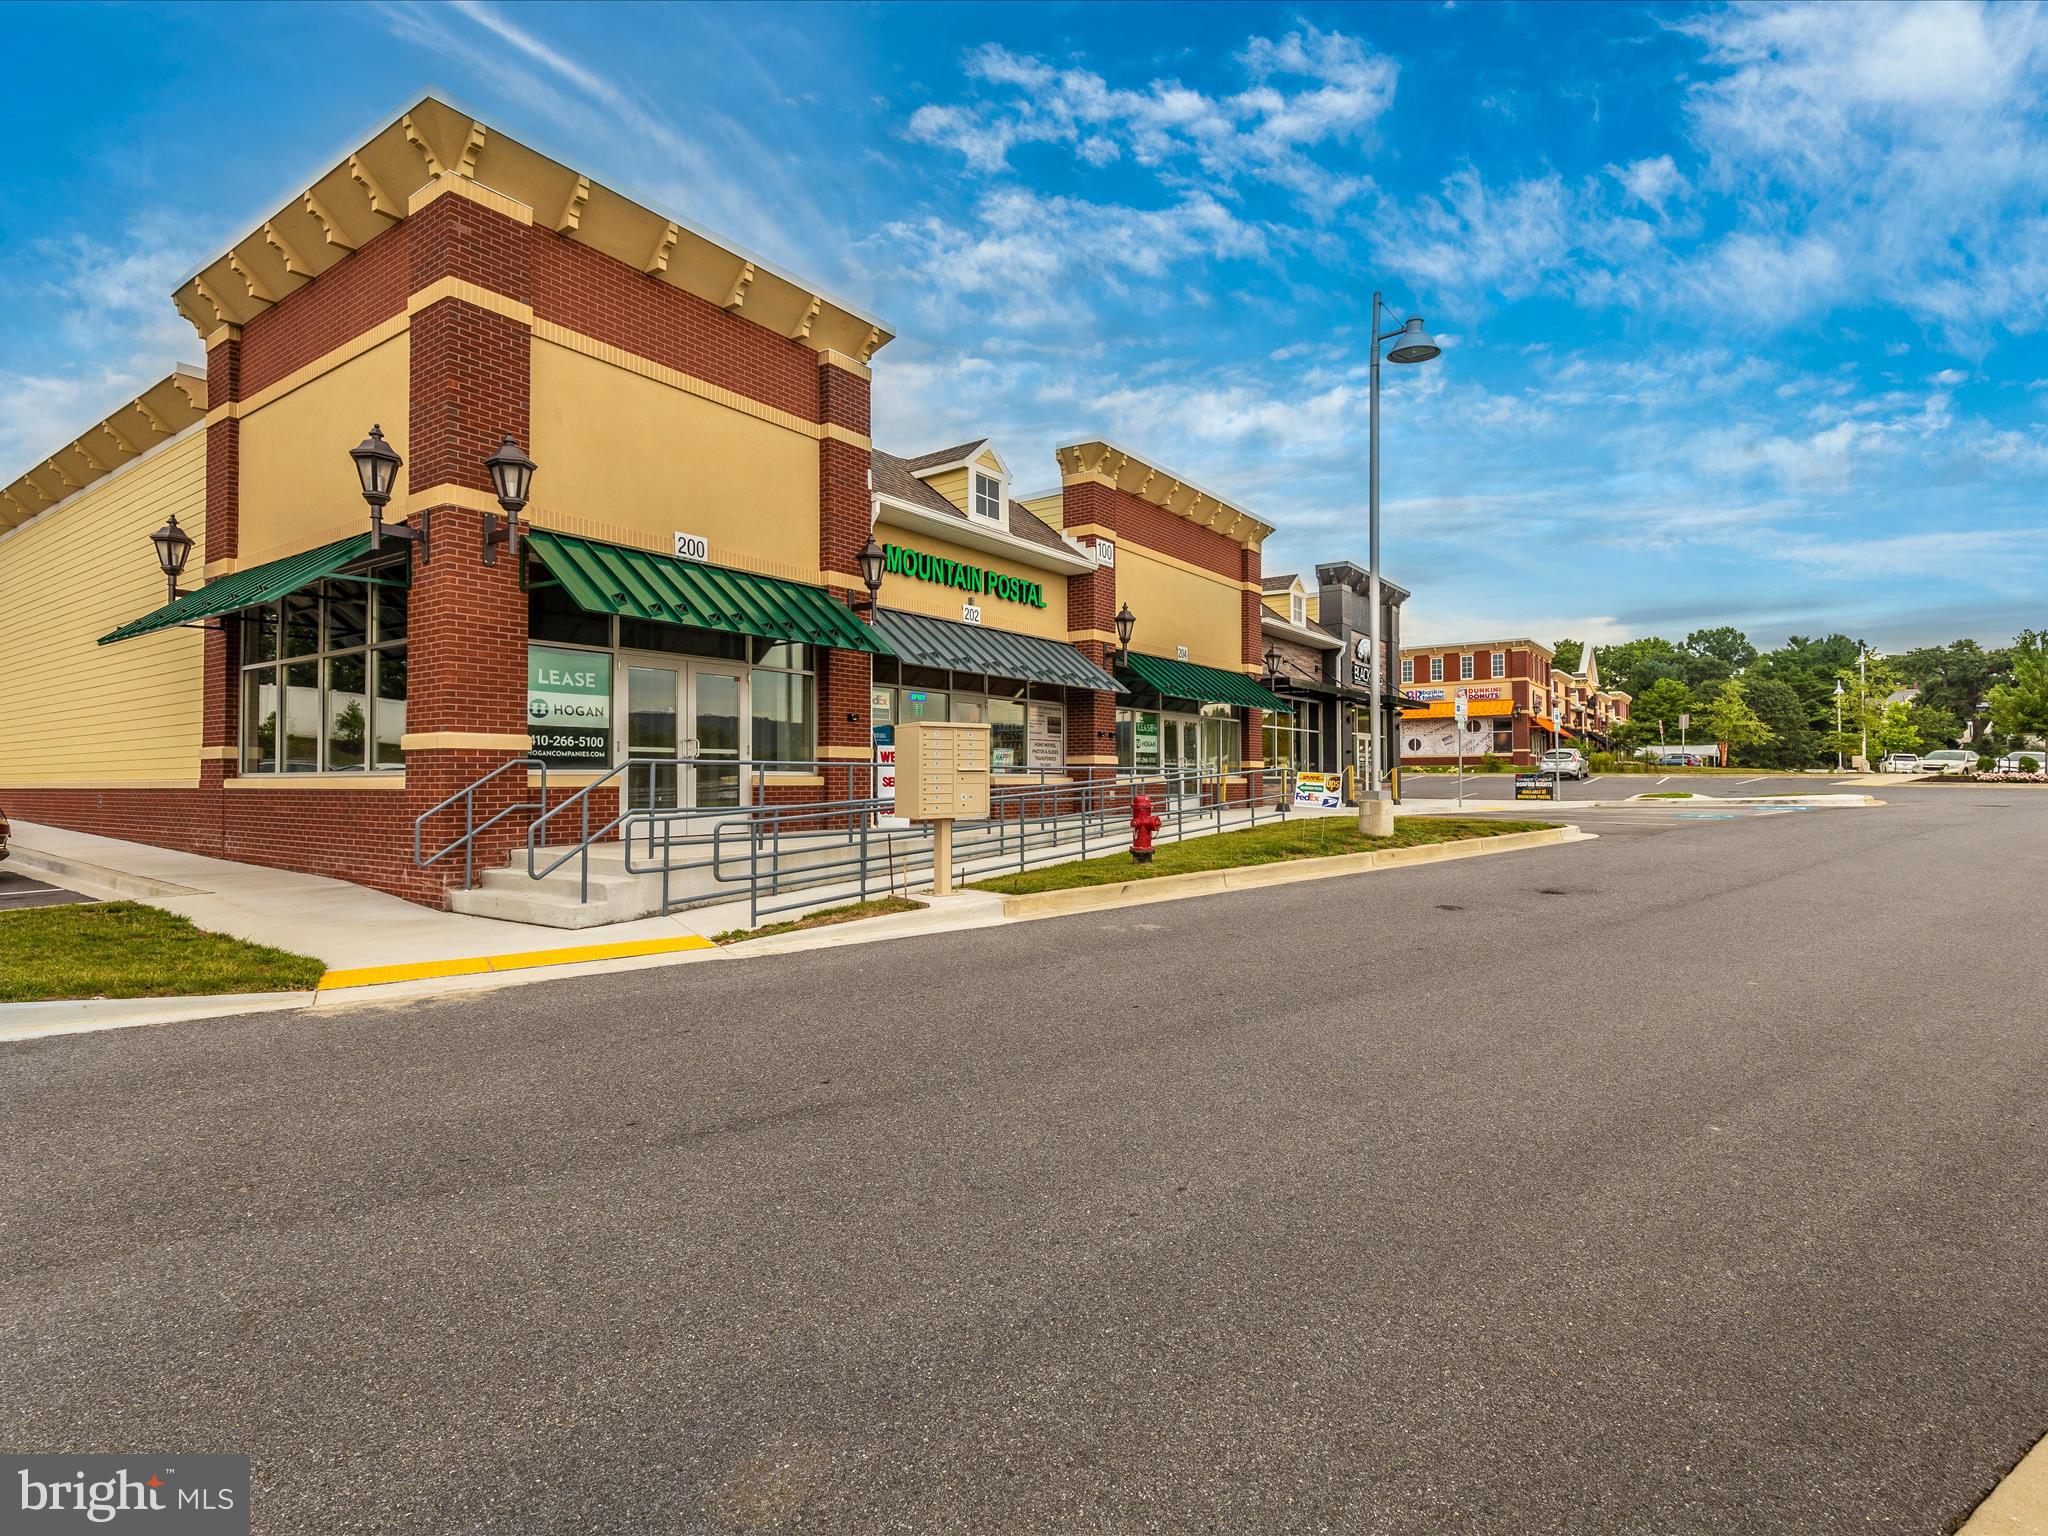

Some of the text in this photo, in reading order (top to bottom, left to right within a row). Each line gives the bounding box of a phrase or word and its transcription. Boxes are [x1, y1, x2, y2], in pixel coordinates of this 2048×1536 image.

[678, 536, 705, 558] 200
[1098, 541, 1112, 560] 100
[884, 544, 1047, 609] MOUNTAIN POSTAL
[964, 607, 980, 622] 202
[1178, 647, 1187, 659] 204
[538, 668, 596, 688] LEASE
[1407, 689, 1422, 700] BR
[553, 703, 605, 718] HOGAN
[1137, 723, 1154, 733] LEASE
[1142, 740, 1157, 748] HOGAN
[1326, 780, 1340, 791] ups
[1295, 792, 1320, 802] FedEx
